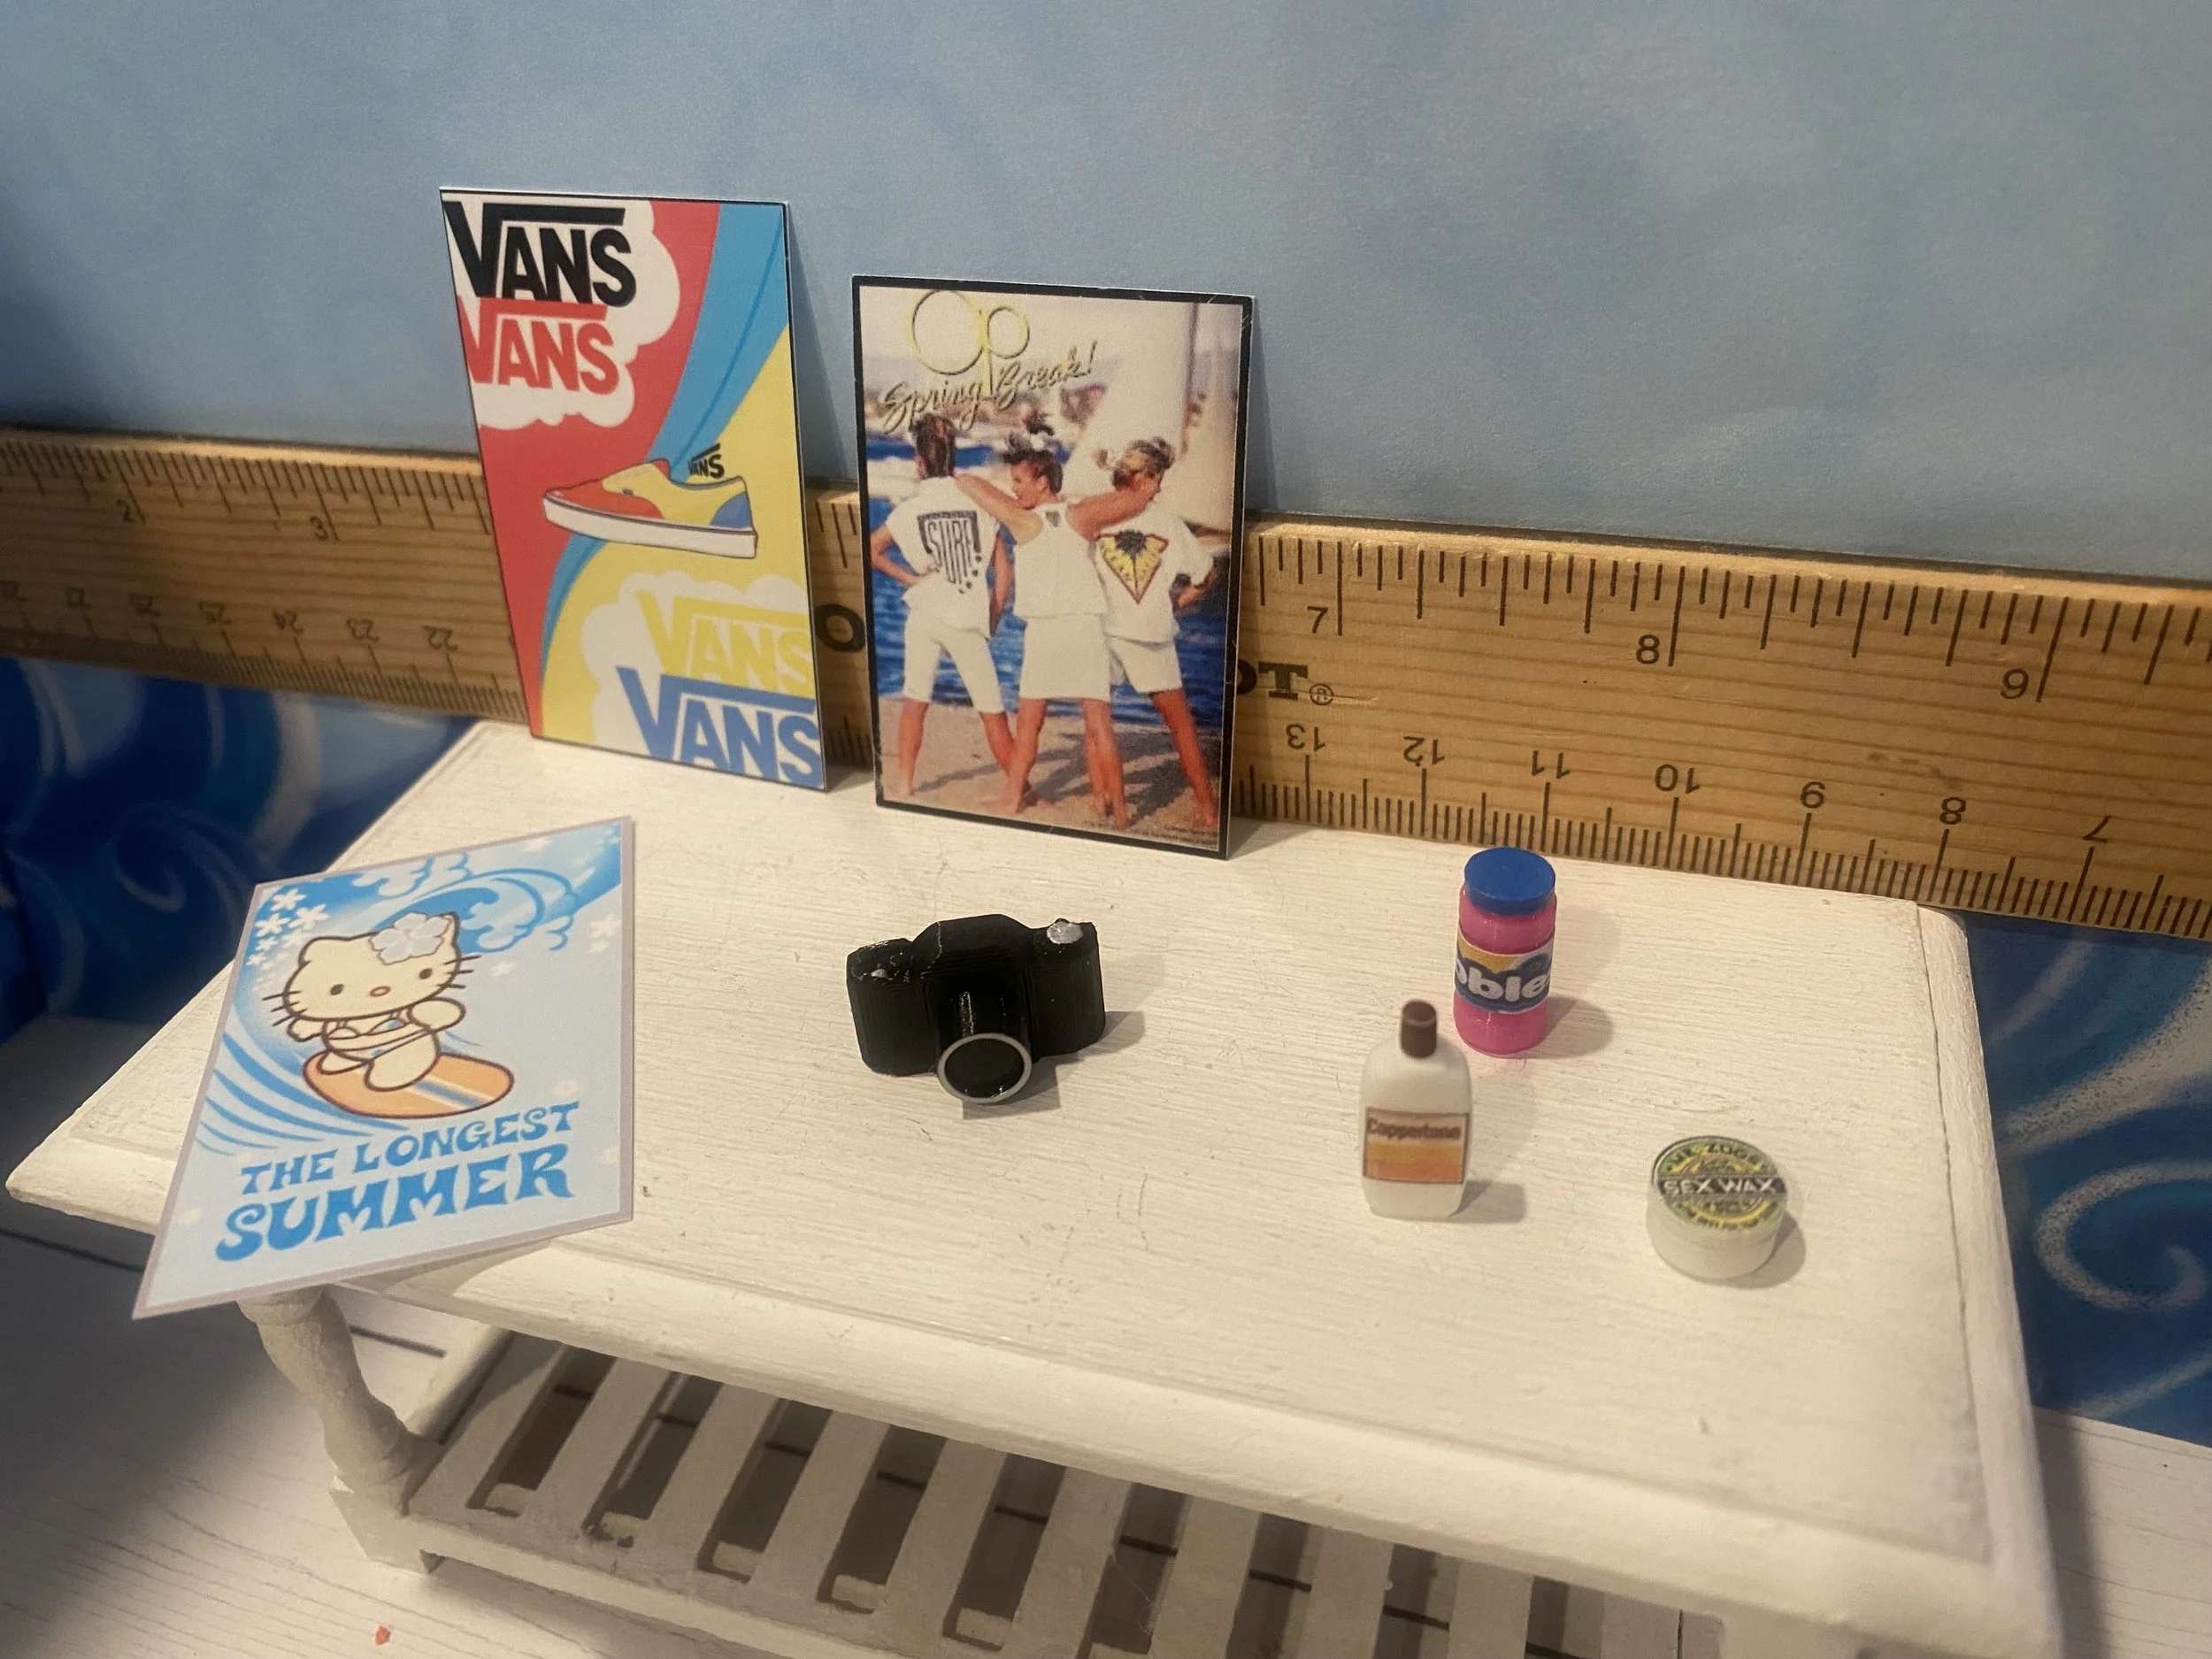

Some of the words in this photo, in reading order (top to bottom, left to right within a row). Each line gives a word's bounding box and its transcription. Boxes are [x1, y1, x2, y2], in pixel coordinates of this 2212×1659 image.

[442, 200, 637, 308] VANS
[457, 296, 620, 396] VANS
[883, 380, 984, 435] Spring
[994, 340, 1097, 411] Break!
[117, 498, 138, 523] 2
[310, 515, 329, 541] 3
[1306, 605, 1329, 634] 7
[1635, 634, 1661, 664] 8
[2000, 668, 2030, 700] 9
[634, 590, 817, 697] VANS
[616, 666, 825, 788] VANS
[1285, 723, 1326, 751] 13
[1402, 735, 1447, 766] 12
[1531, 749, 1571, 779] 11
[1654, 764, 1701, 795] 10
[1938, 796, 1967, 826] 8
[2083, 815, 2112, 844] 7
[241, 1149, 339, 1195] THE
[351, 1101, 580, 1175] LONGEST
[1663, 1177, 1715, 1197] SEX
[1717, 1175, 1778, 1195] WAX
[215, 1143, 575, 1263] SUMMER
